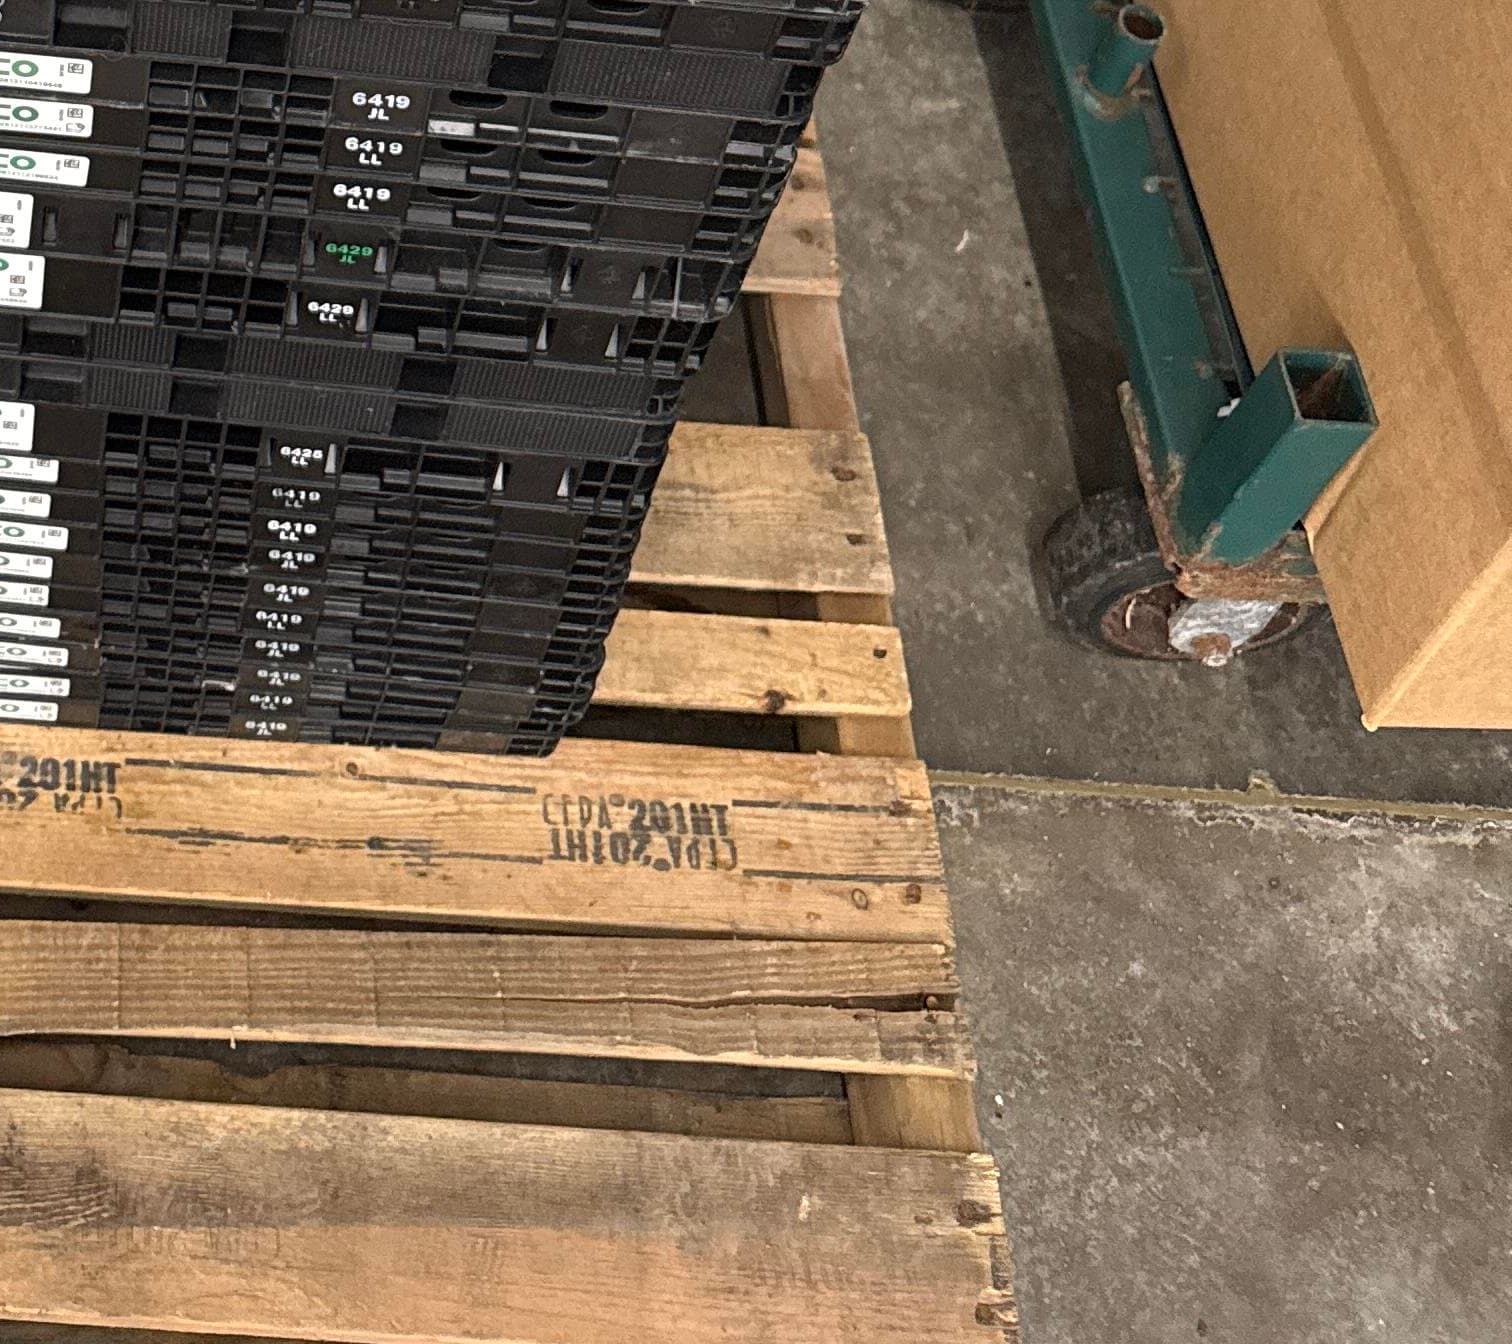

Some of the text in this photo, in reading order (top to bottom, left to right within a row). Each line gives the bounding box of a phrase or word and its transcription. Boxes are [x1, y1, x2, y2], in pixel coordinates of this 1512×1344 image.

[352, 92, 411, 109] 6419
[367, 108, 390, 121] JL
[345, 136, 403, 155] 6419
[358, 152, 383, 166] LL
[333, 183, 391, 201] 6419
[347, 198, 370, 211] LL
[325, 243, 374, 256] 6429
[339, 255, 356, 264] JL
[319, 312, 338, 323] LL
[291, 455, 308, 466] LL
[271, 487, 321, 502] 6419
[285, 499, 303, 508] LL
[279, 530, 300, 542] LL
[280, 559, 299, 570] JL
[17, 755, 122, 795] 201HT
[626, 798, 729, 837] 201HT
